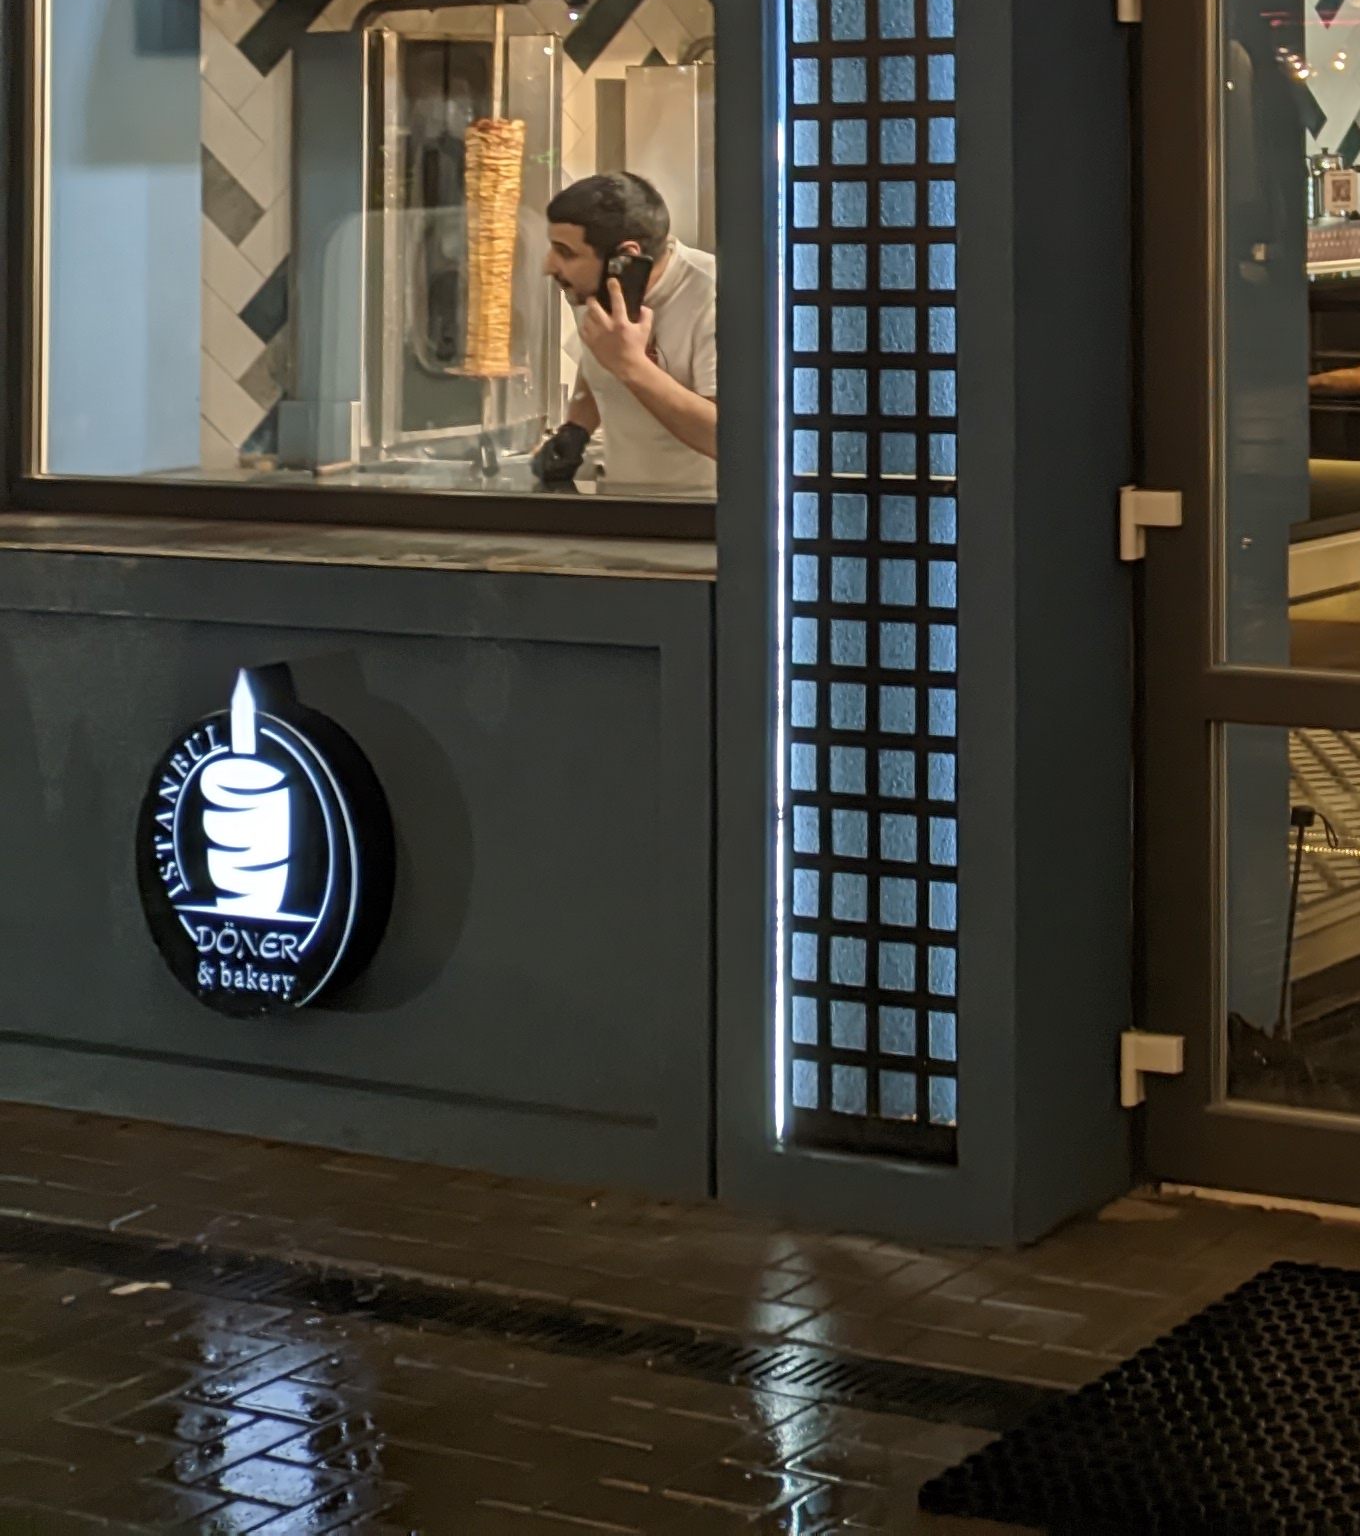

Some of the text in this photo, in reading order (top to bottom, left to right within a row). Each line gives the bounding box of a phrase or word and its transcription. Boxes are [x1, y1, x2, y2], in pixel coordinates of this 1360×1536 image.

[154, 724, 226, 898] ISTANBUL
[196, 922, 301, 963] DÖNER
[197, 961, 296, 1000] & bakery
